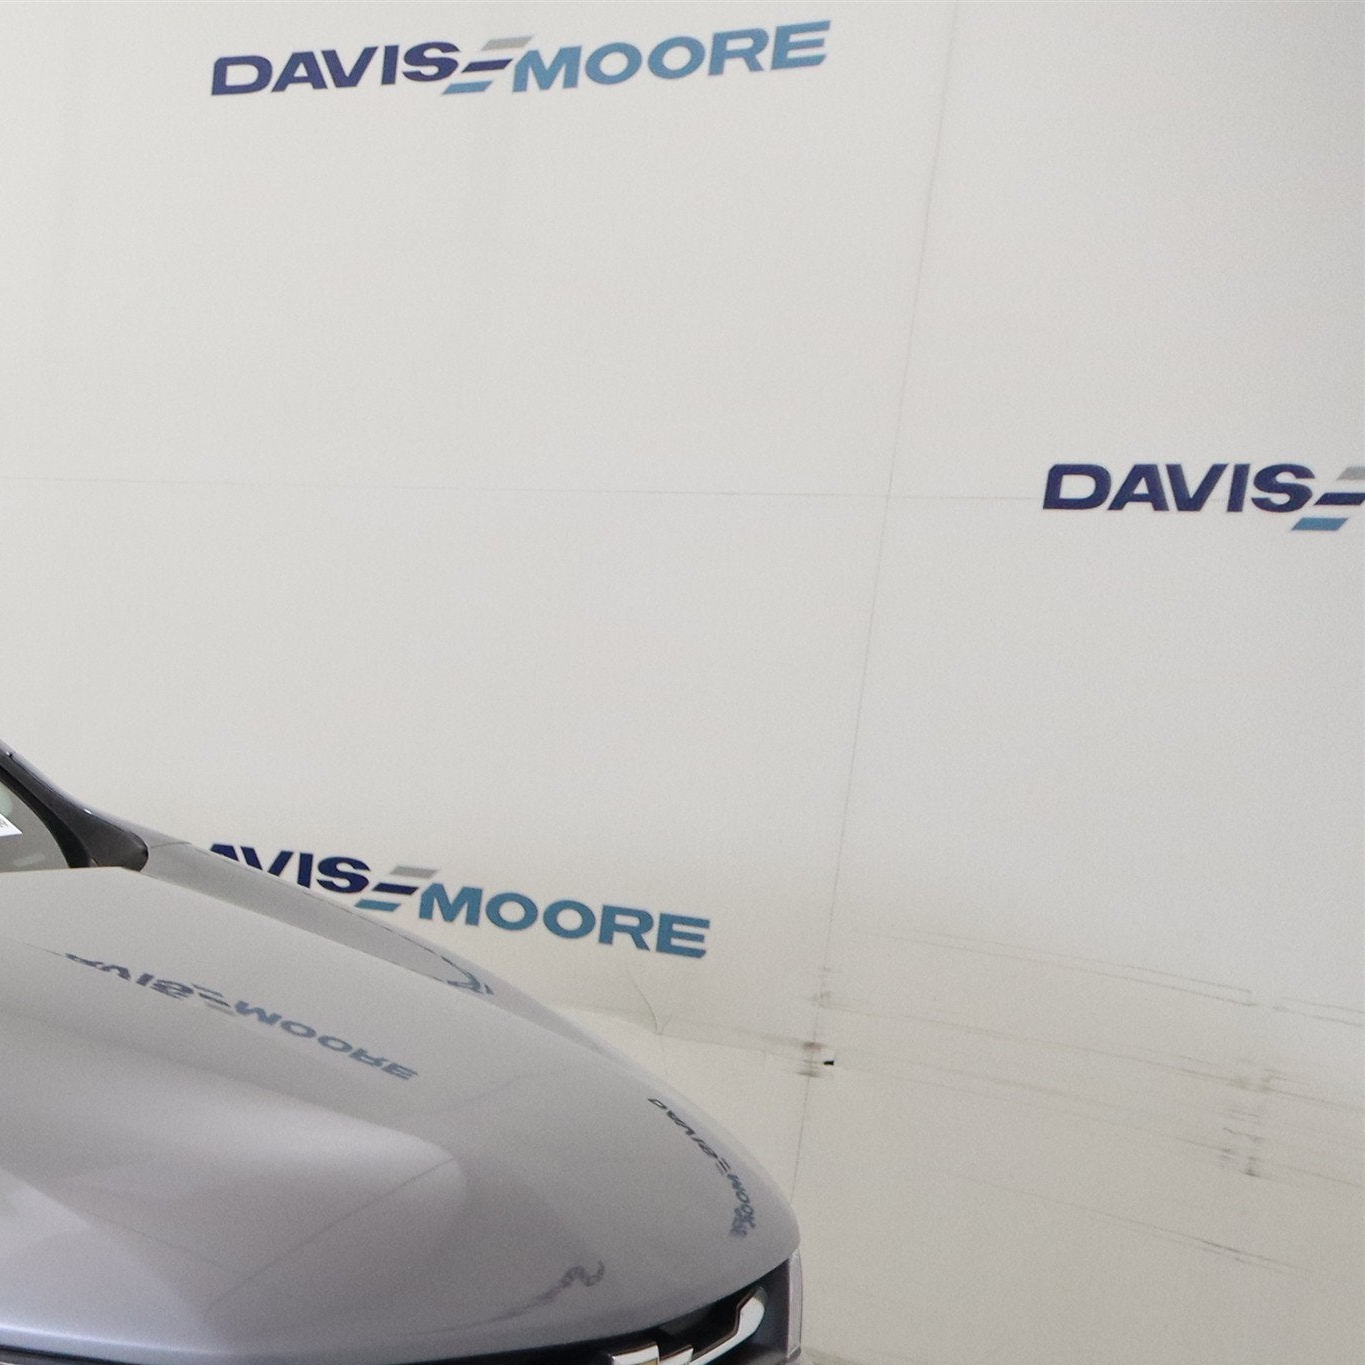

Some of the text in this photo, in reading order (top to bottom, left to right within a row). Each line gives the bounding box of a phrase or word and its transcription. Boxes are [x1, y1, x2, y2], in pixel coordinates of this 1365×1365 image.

[211, 19, 831, 96] DAVIS MOORE
[1043, 462, 1316, 513] DAVIS
[418, 882, 710, 959] MOORE
